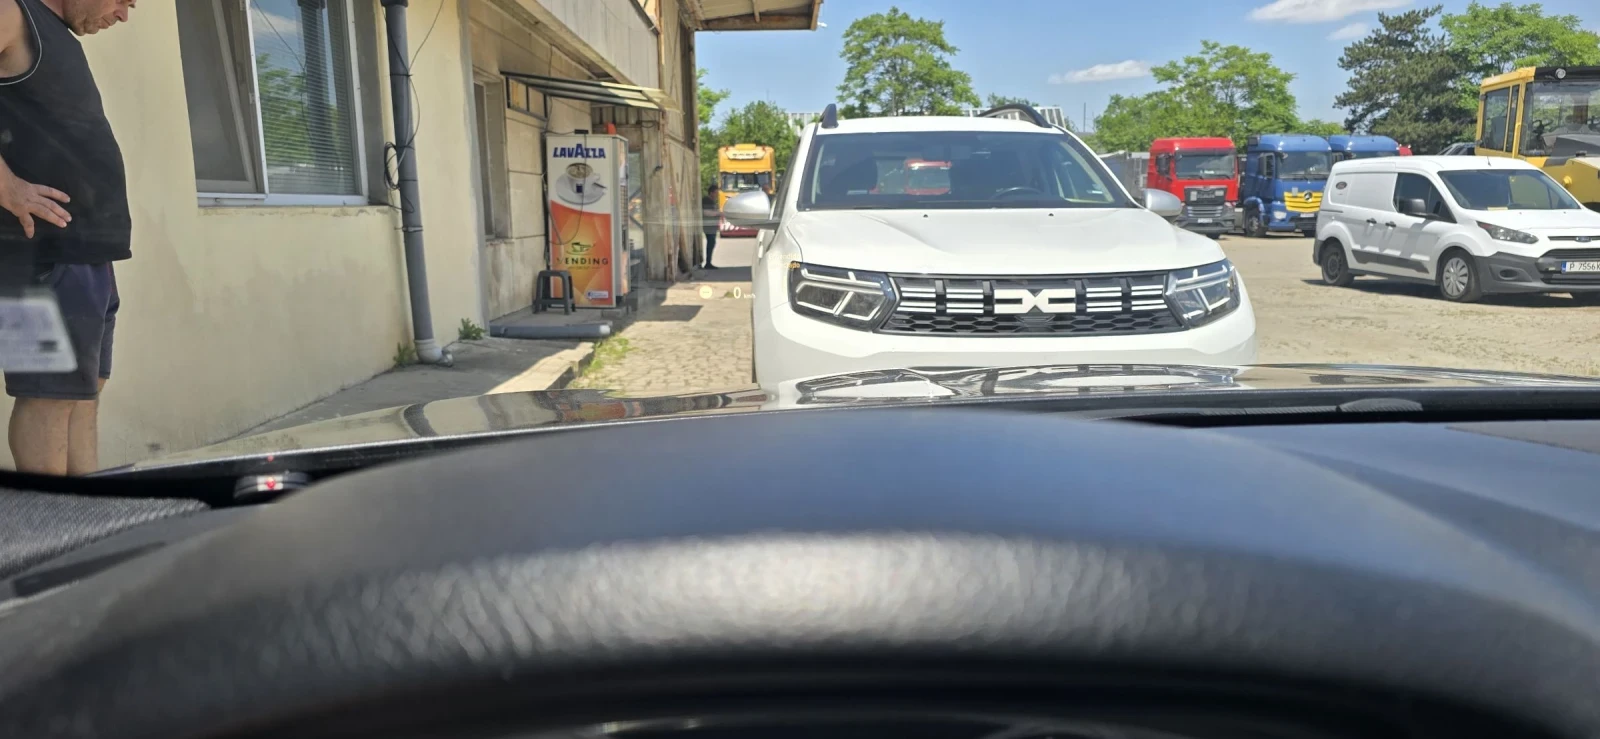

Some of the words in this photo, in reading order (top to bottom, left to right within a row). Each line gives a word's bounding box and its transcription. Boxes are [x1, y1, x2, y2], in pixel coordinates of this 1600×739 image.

[552, 143, 606, 159] LAVAZZA
[556, 257, 609, 265] VENDING
[1569, 262, 1575, 270] P
[1578, 262, 1596, 270] 7556
[733, 286, 741, 299] 0
